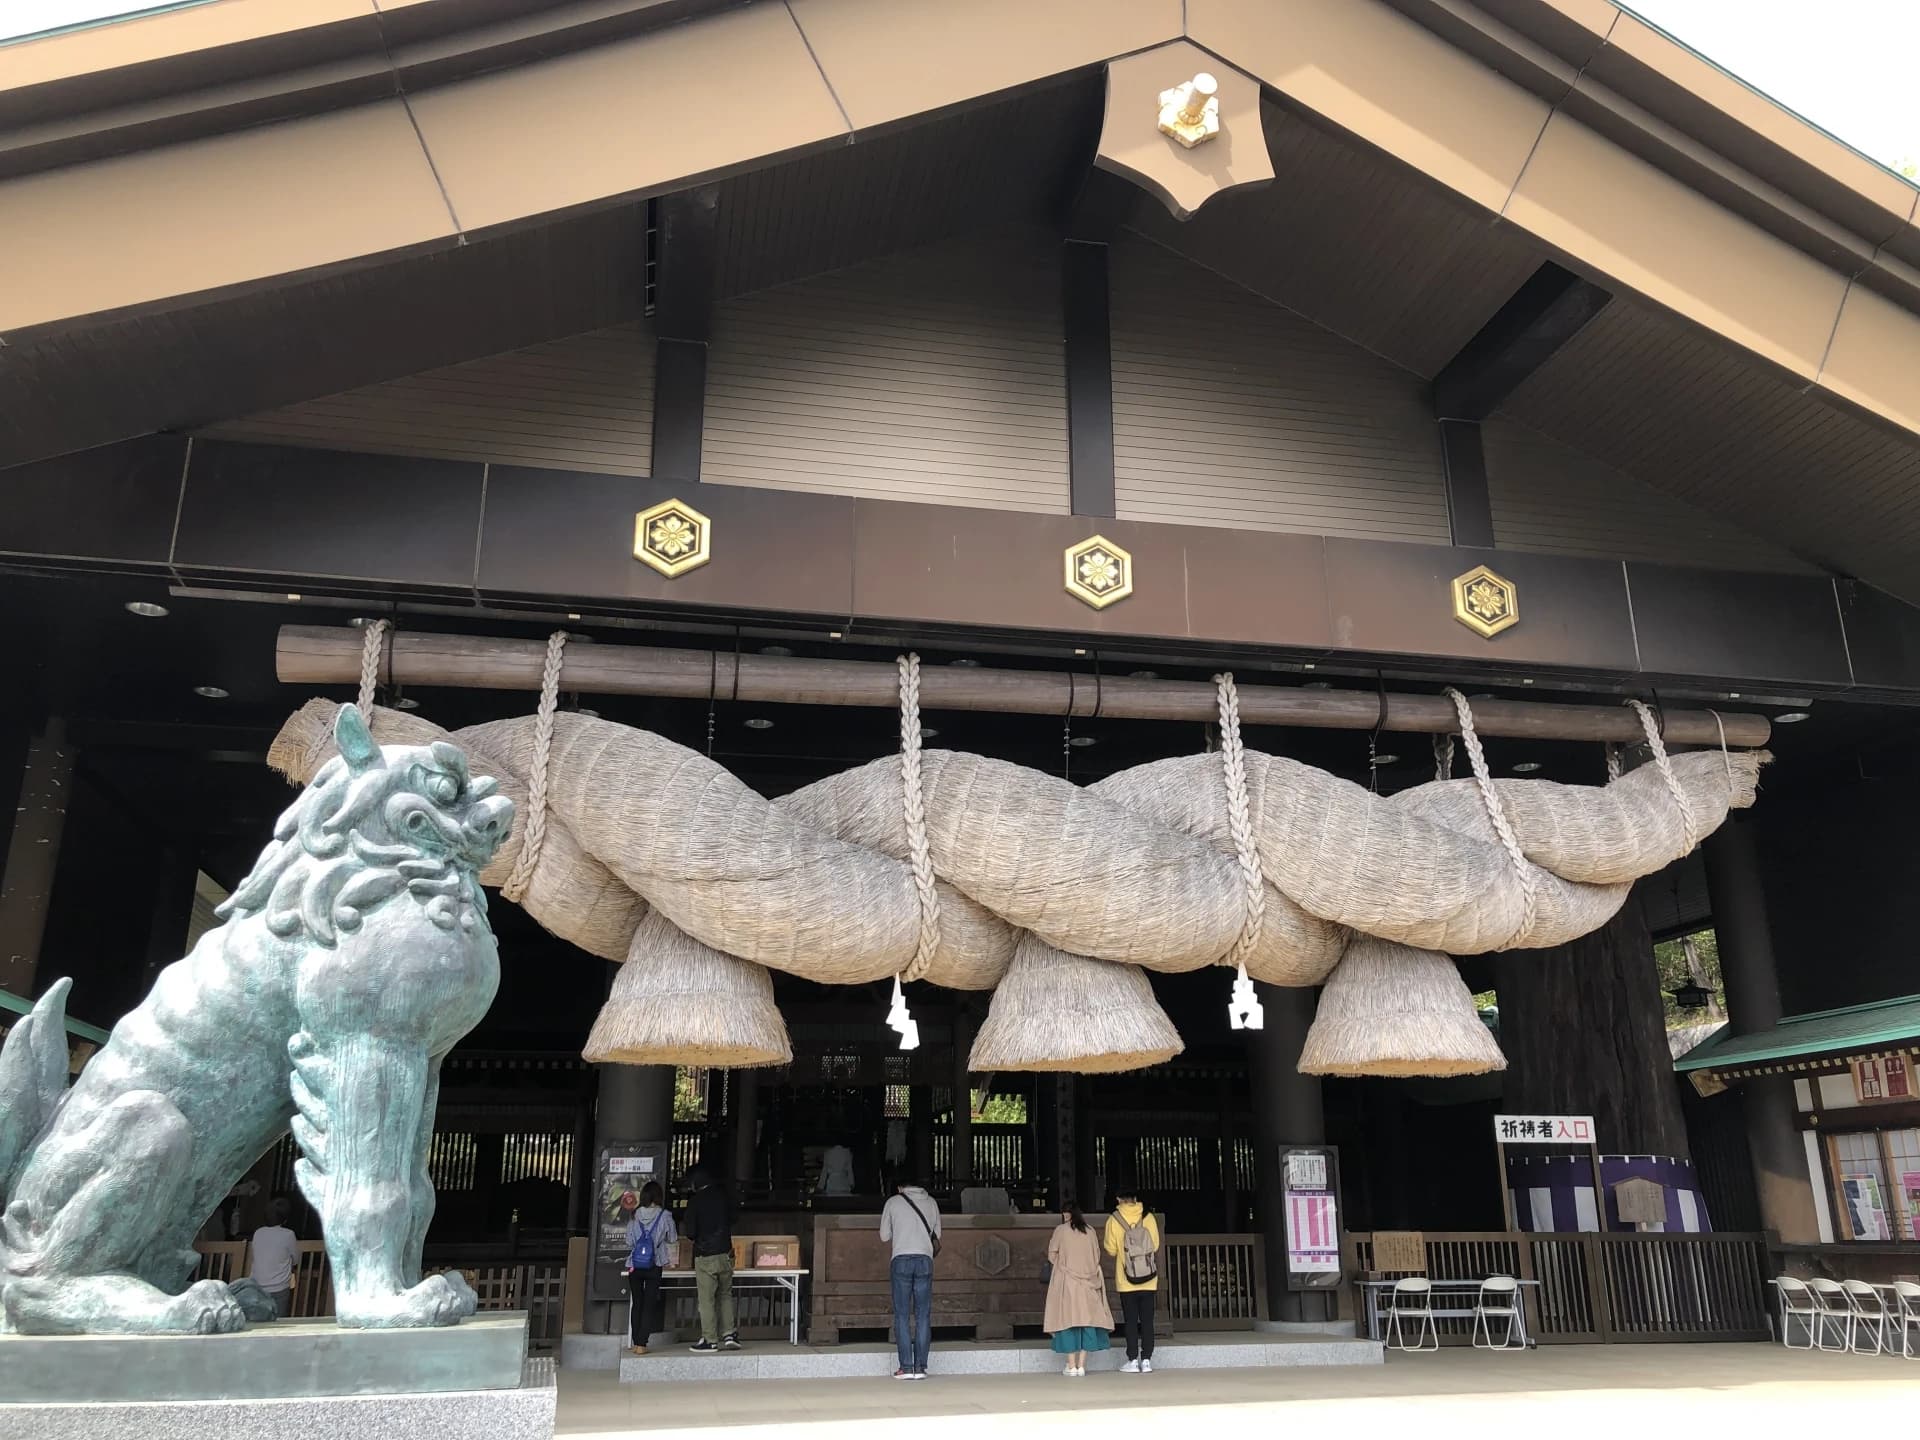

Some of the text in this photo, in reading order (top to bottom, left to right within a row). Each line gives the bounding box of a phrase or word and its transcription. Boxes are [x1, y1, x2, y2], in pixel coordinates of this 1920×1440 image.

[1501, 1120, 1588, 1139] 祈祷者入口
